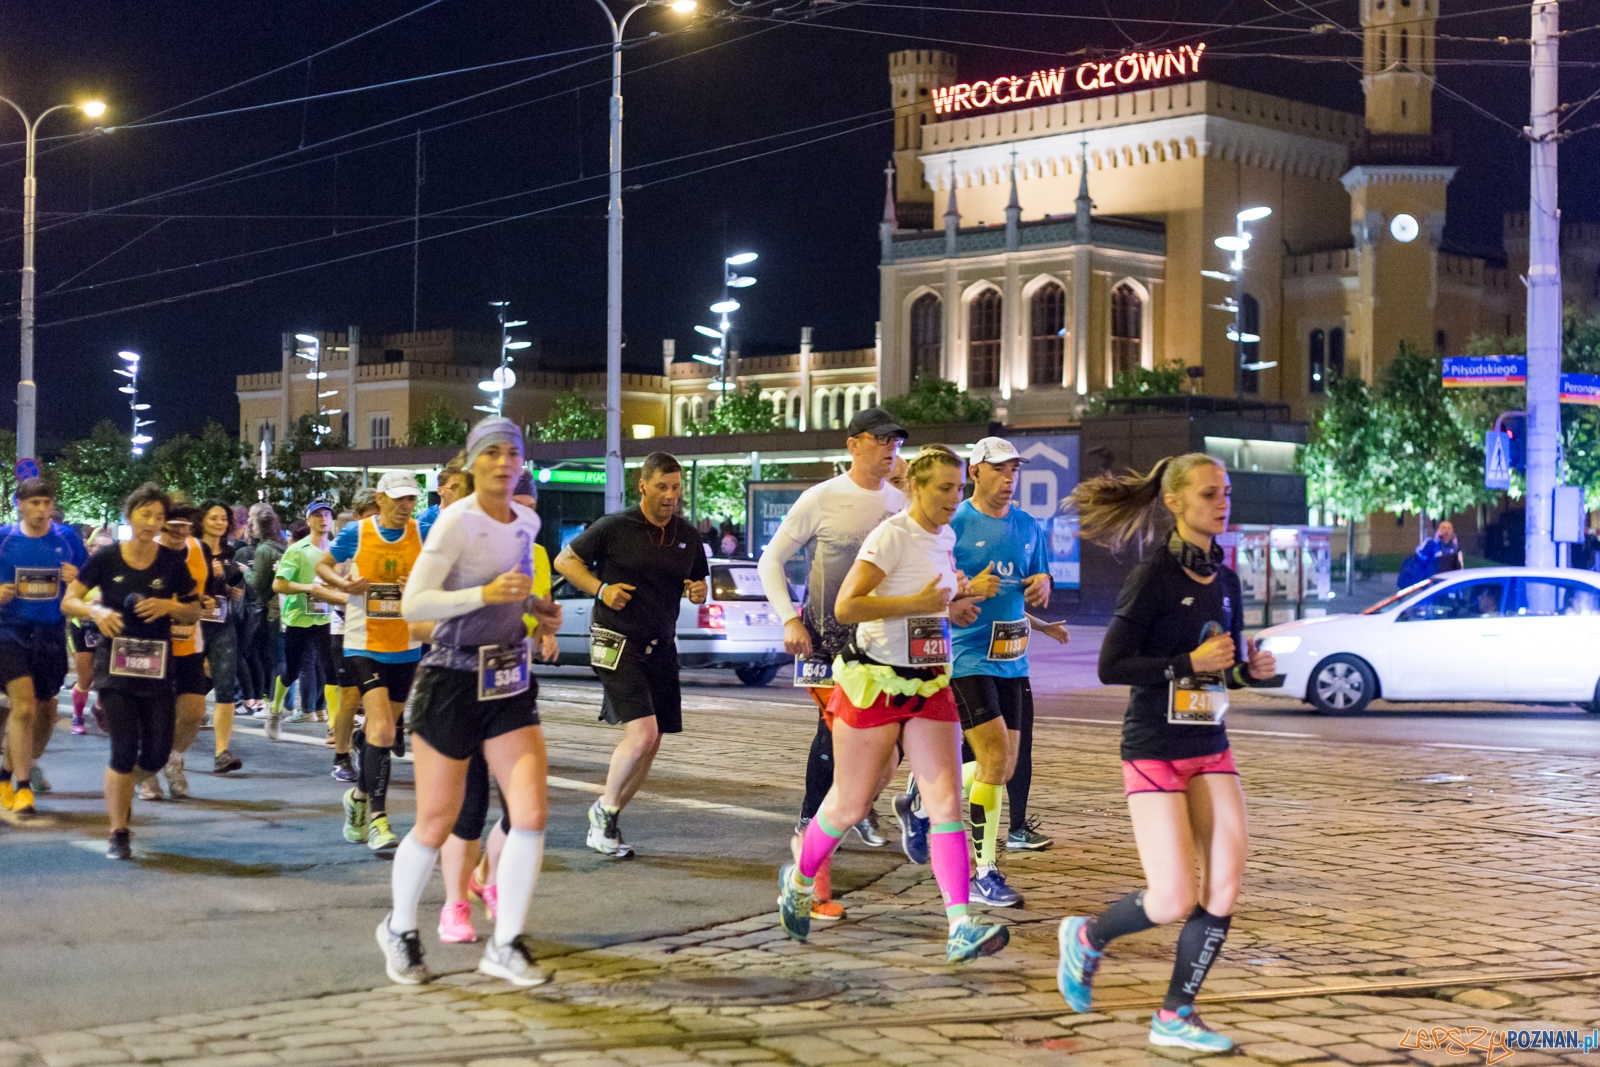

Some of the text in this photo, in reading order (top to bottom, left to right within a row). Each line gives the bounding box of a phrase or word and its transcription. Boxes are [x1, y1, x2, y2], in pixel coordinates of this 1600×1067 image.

[931, 42, 1206, 115] WROCŁAW GŁÓWNY
[379, 600, 399, 612] 942
[922, 639, 948, 655] 4211
[802, 662, 827, 678] 6543
